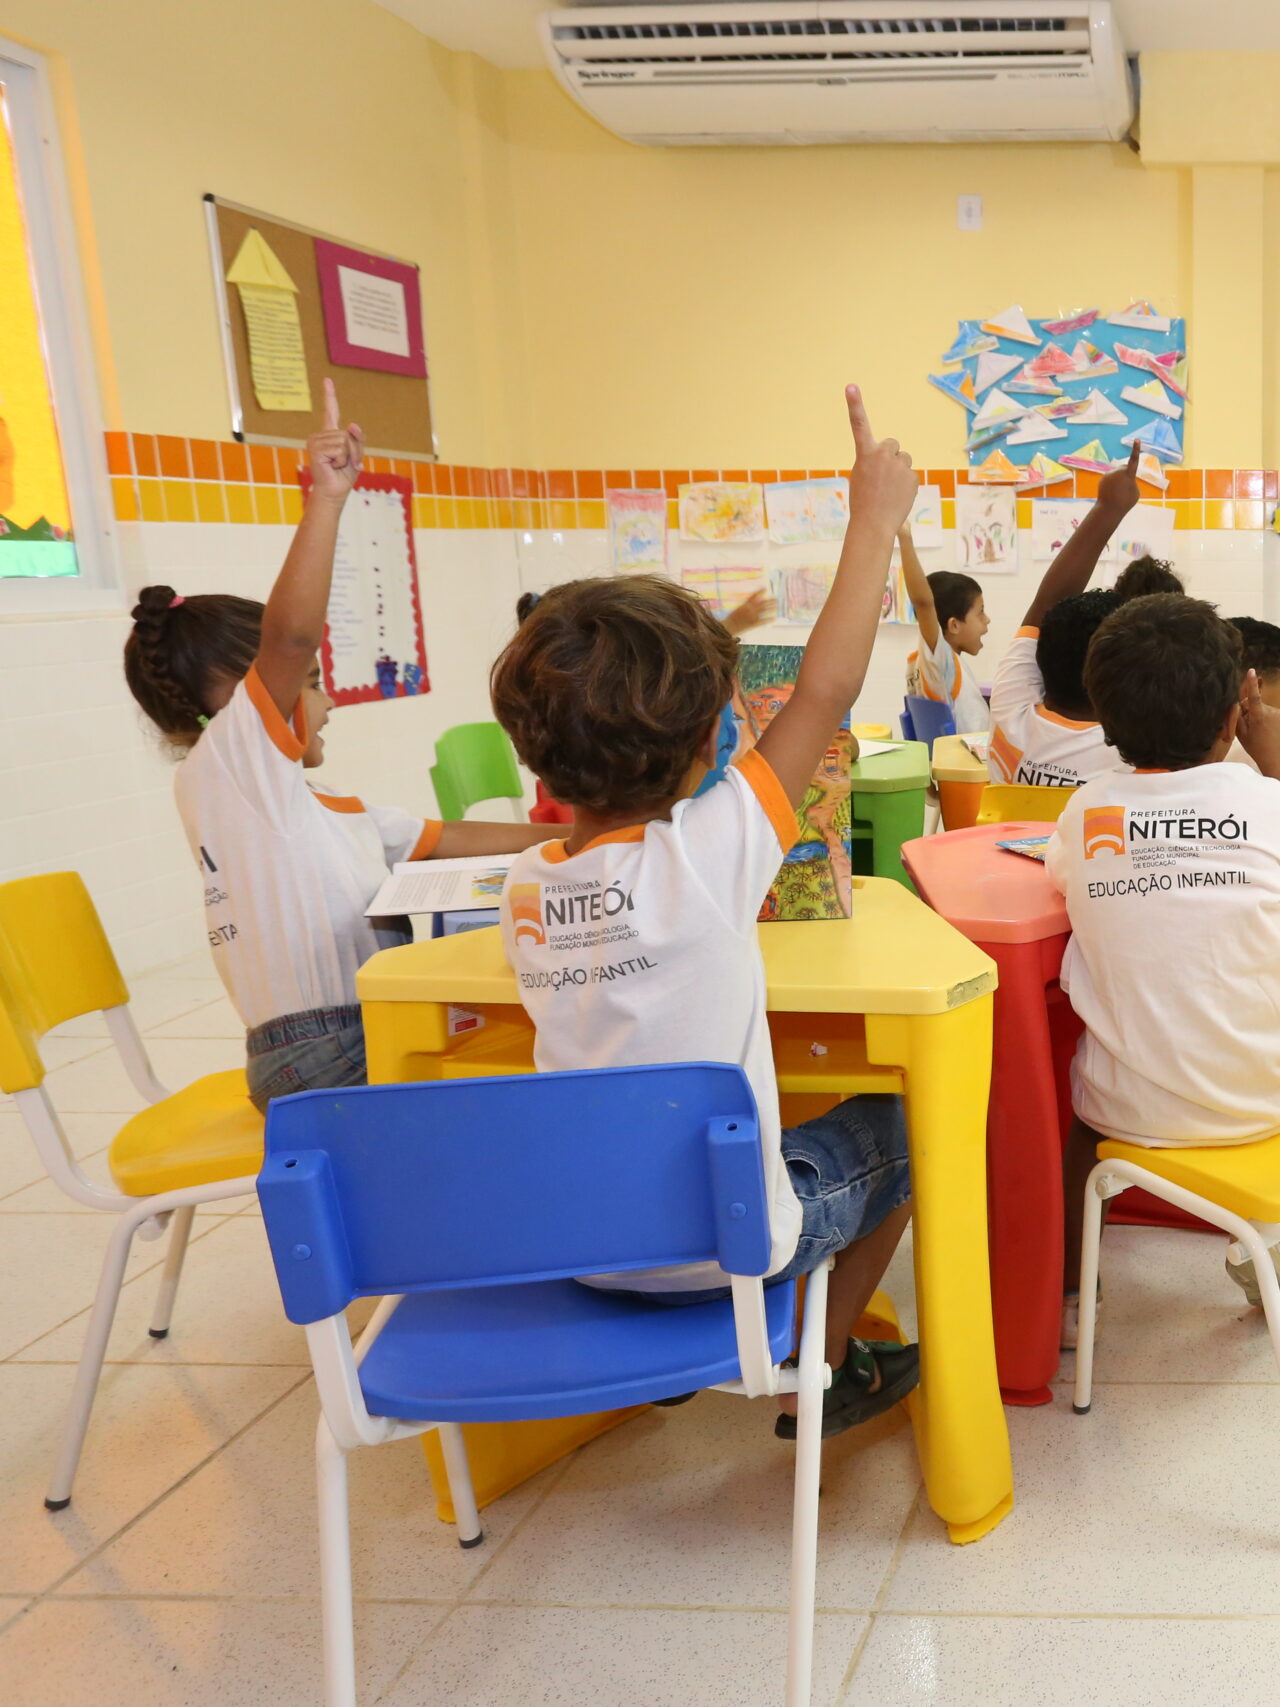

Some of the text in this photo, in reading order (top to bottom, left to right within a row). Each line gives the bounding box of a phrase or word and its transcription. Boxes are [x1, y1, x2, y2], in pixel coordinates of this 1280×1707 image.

[1130, 809, 1196, 818] PREFEITURA
[1129, 813, 1248, 841] NITERÓI
[1132, 852, 1165, 862] FUNDAÇÃO
[1143, 860, 1177, 869] EDUCAÇÃO
[545, 880, 601, 894] PREFEITURA
[1088, 871, 1251, 898] EDUCAÇÃO INFANTIL
[521, 967, 587, 991] EDUCAÇÃO
